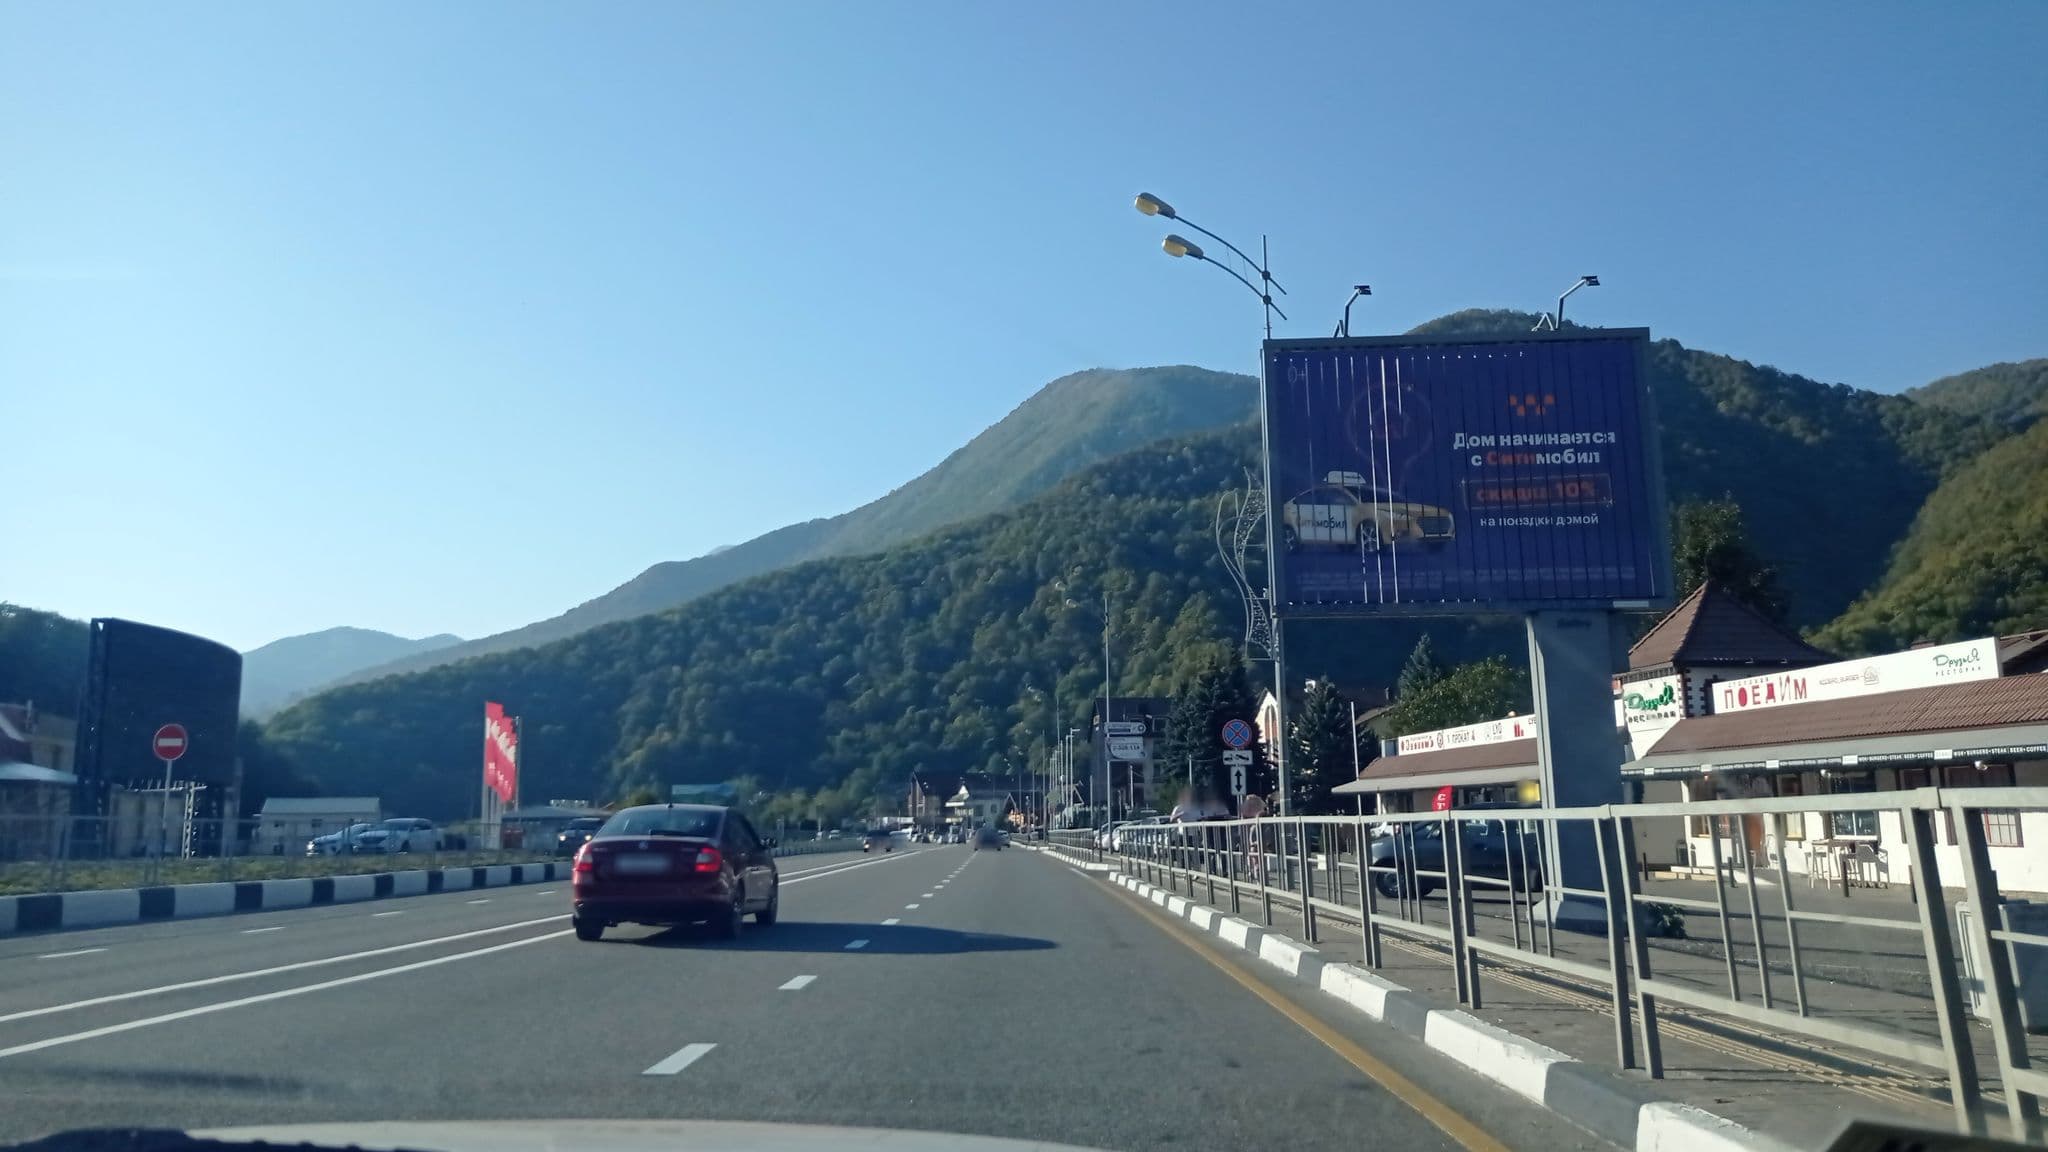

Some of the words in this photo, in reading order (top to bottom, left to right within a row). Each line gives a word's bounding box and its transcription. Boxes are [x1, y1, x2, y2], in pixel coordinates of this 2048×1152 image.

[1453, 432, 1496, 450] Дом
[1500, 430, 1616, 447] начинается
[1471, 454, 1483, 467] с
[1480, 516, 1496, 527] на
[1499, 515, 1553, 529] поездки
[1556, 512, 1600, 527] домой
[1724, 674, 1808, 709] ПОЕДИМ
